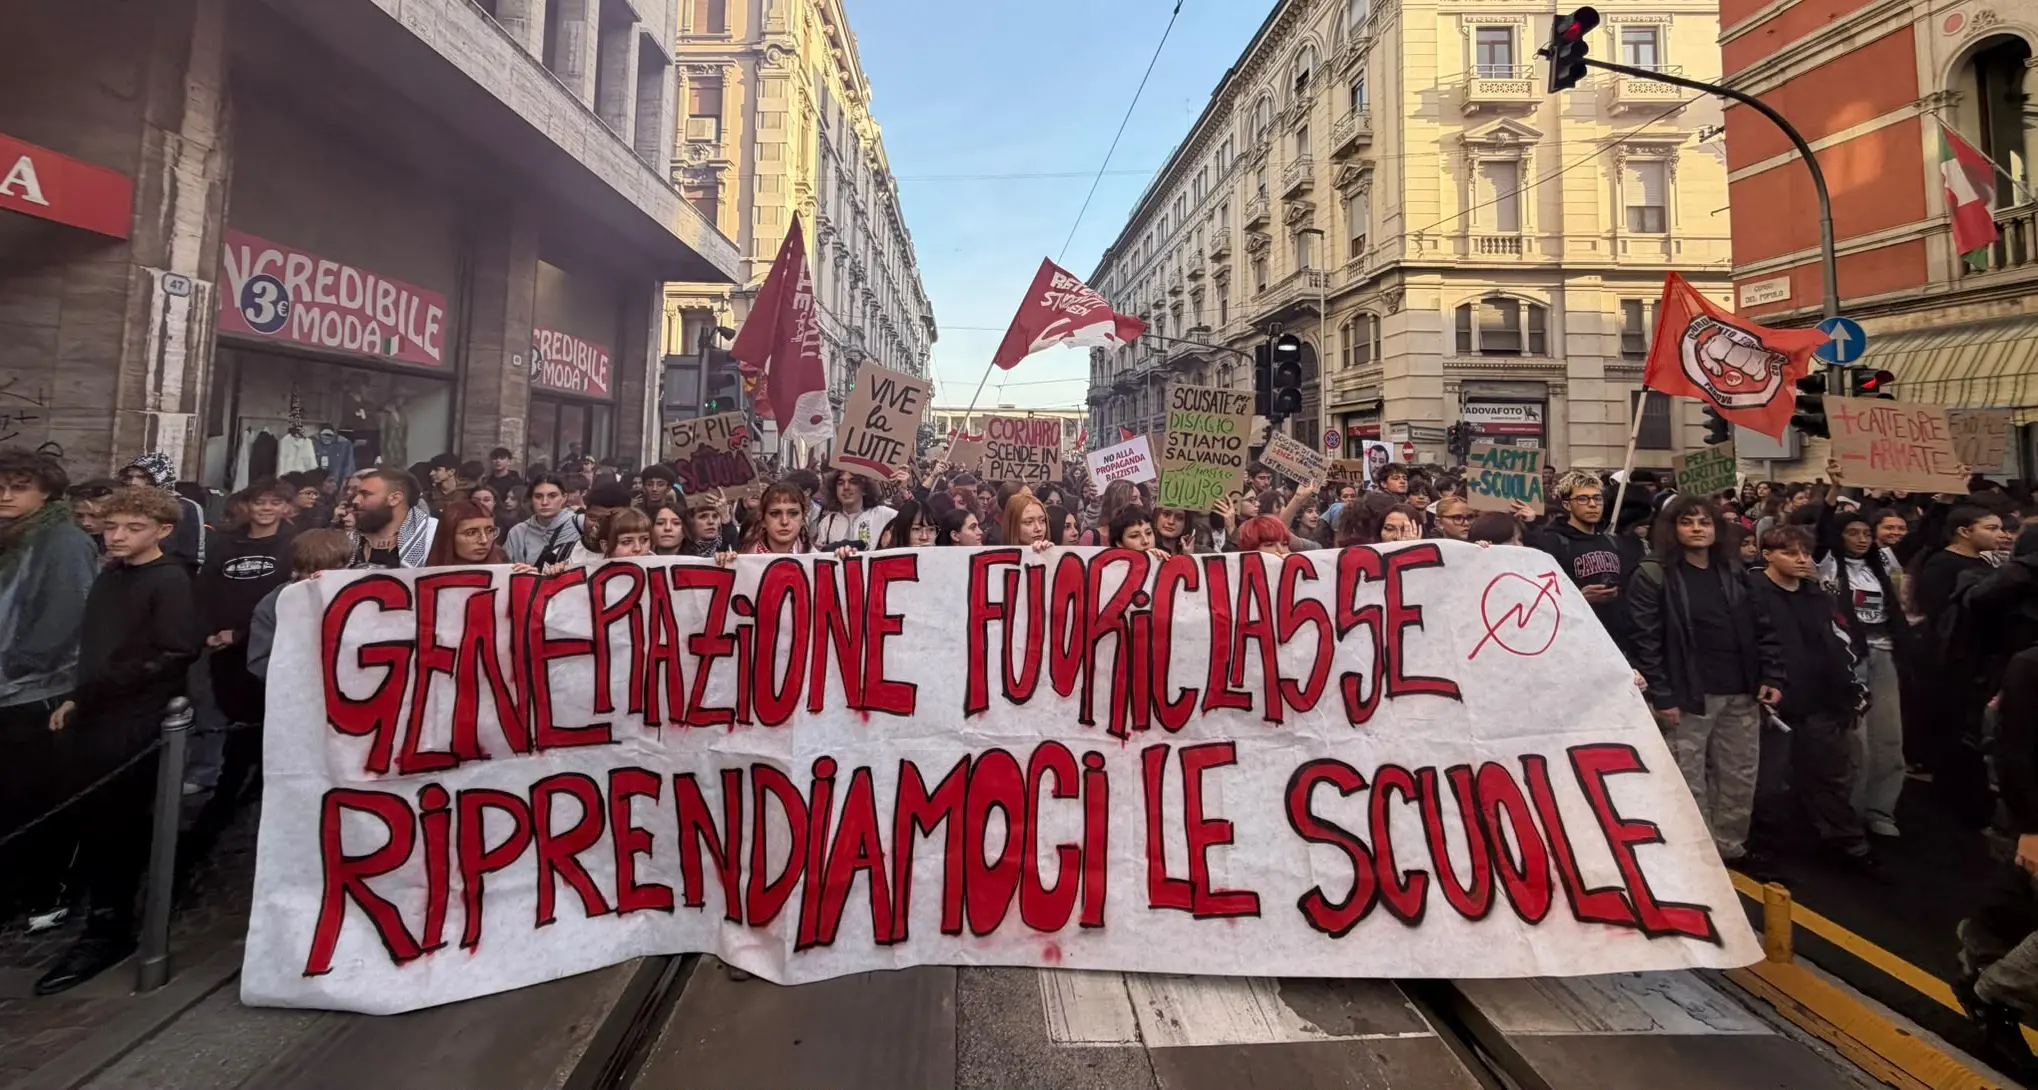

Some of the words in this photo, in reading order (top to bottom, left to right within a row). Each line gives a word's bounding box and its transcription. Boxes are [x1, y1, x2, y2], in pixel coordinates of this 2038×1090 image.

[170, 279, 184, 291] 47
[219, 243, 443, 361] NCREDIBILE
[292, 303, 381, 354] MODA
[533, 328, 608, 392] REDIBILE
[542, 361, 580, 390] MODA
[871, 374, 921, 415] VIVE
[1172, 387, 1233, 415] SCUSATE
[1233, 394, 1251, 405] per
[865, 404, 892, 432] la
[1236, 404, 1246, 415] il
[1465, 407, 1522, 415] ADOVAFOTO
[705, 416, 734, 441] PIL
[988, 418, 1061, 447] CORNARO
[1170, 411, 1234, 434] DISAGIO
[843, 426, 905, 465] LUTTE
[985, 441, 1038, 463] SCENDE
[1042, 447, 1058, 464] IN
[1168, 431, 1242, 450] STIAMO
[1095, 453, 1145, 475] PROPAGANDA
[1103, 453, 1115, 464] NO
[1115, 447, 1135, 461] ALLA
[1165, 447, 1242, 467] SALVANDO
[1272, 447, 1294, 462] SENZA
[990, 460, 1051, 480] PIAZZA
[1105, 465, 1140, 482] RAZZISTA
[1265, 456, 1309, 486] ISTRUZIONE
[1678, 457, 1736, 486] DIRITTO
[1140, 740, 1262, 921] LE
[1285, 743, 1725, 947] SCUOLE
